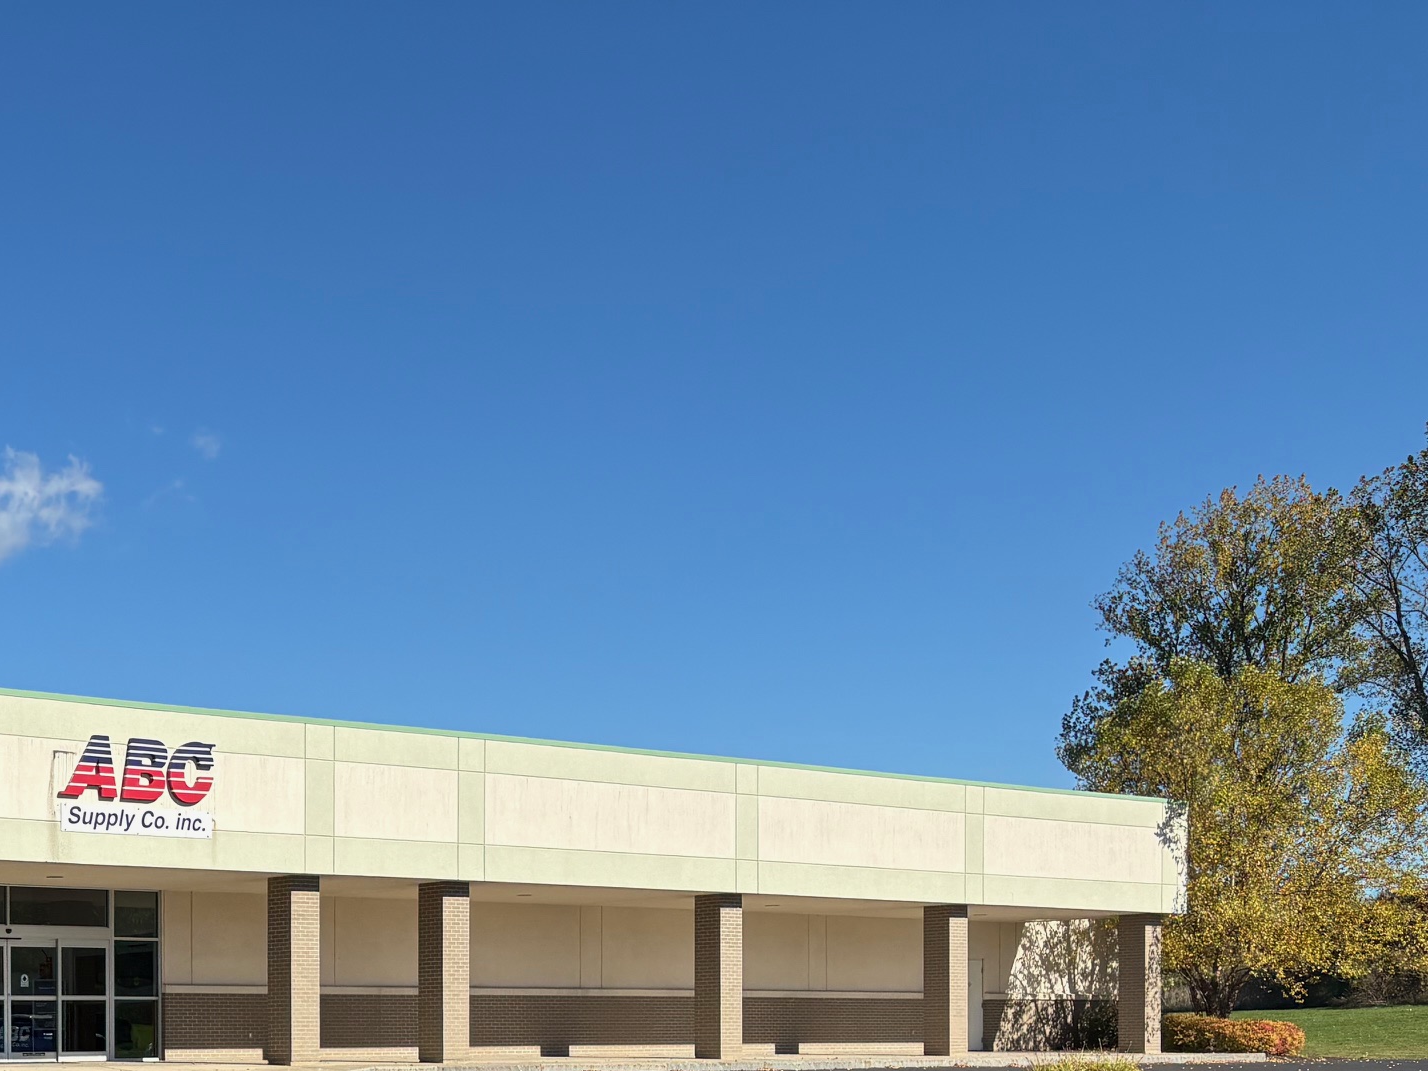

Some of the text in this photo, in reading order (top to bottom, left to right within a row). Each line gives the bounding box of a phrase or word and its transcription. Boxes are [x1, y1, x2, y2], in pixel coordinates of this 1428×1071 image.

[57, 734, 216, 807] ABC
[68, 805, 206, 832] Supply Co. inc.
